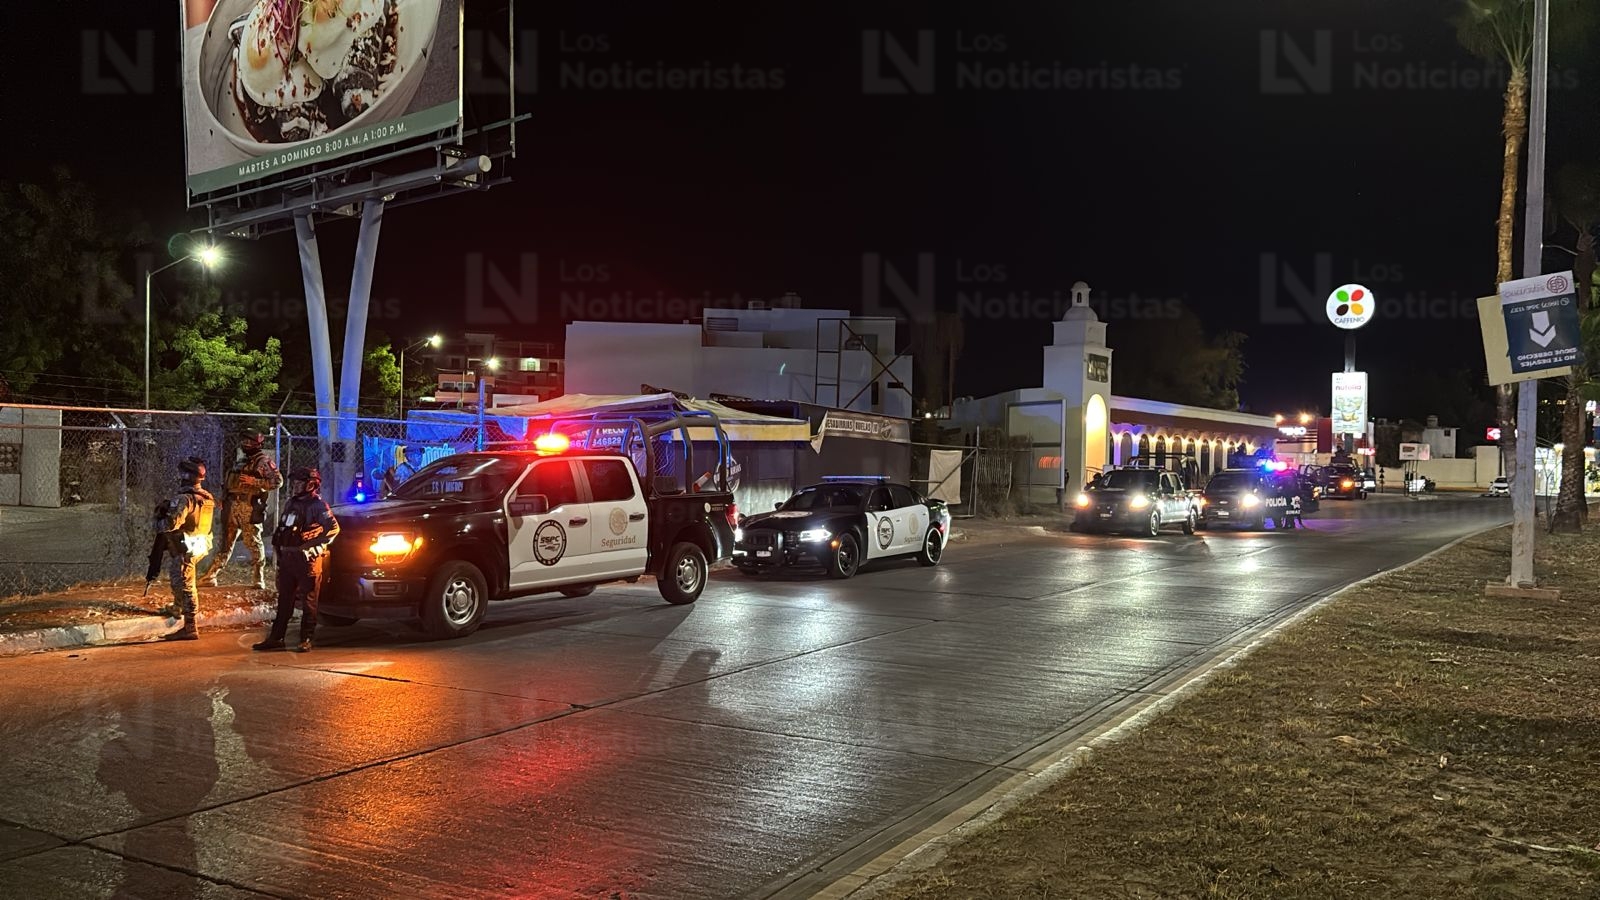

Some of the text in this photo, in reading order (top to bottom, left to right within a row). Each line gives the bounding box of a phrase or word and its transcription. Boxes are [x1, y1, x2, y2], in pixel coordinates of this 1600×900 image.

[238, 122, 407, 176] MARTES A DOMINGO 8:00 A.M. A 1:00 P.M.
[1517, 347, 1578, 361] SIGUE DERECHO
[1265, 496, 1287, 507] POLICÍA
[540, 535, 560, 544] SSPC
[601, 536, 636, 548] Seguridad
